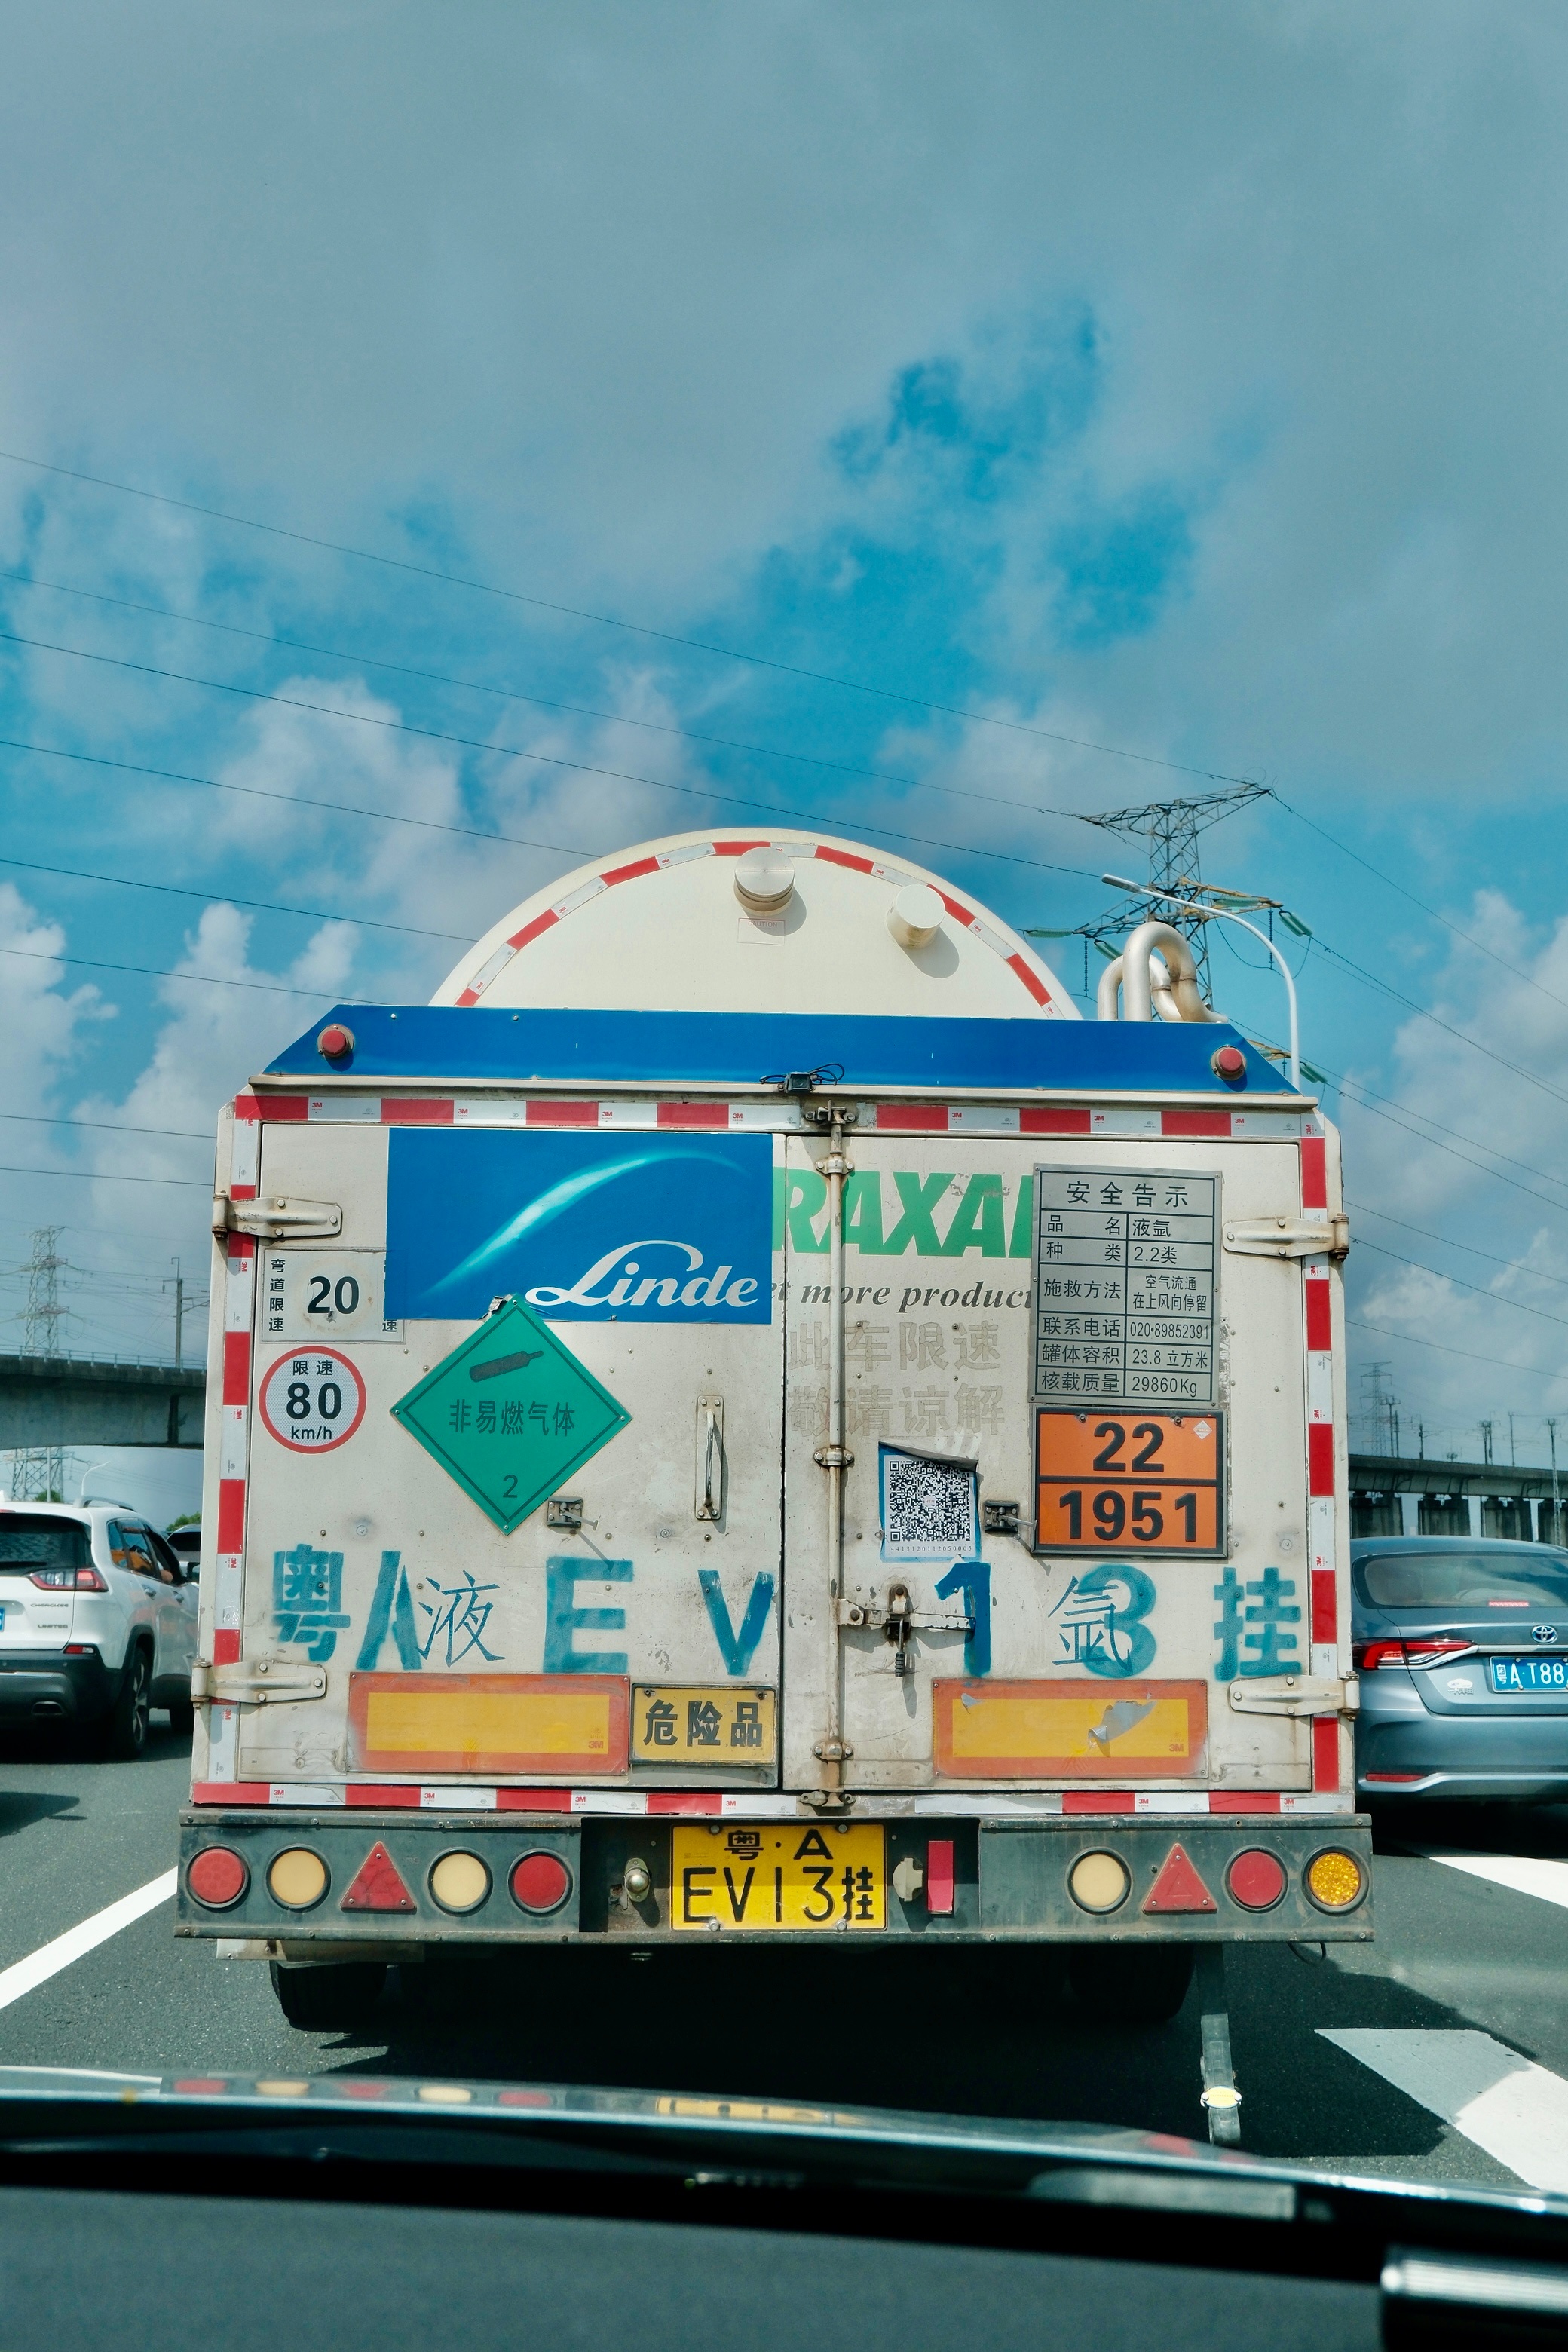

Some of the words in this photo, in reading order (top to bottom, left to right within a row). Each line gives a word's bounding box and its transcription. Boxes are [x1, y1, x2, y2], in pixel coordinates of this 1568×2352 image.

[1067, 1181, 1188, 1208] 安全告示
[1132, 1218, 1171, 1238] 液氩
[241, 1260, 247, 1272] 3M
[1133, 1246, 1178, 1265] 2.2类
[525, 1239, 758, 1308] Linde
[1145, 1274, 1197, 1291] 空气流通
[268, 1258, 286, 1332] 弯道限速
[307, 1276, 360, 1315] 20
[801, 1285, 891, 1305] more
[1043, 1279, 1122, 1300] 施救方法
[1132, 1291, 1207, 1312] 在上风向停留
[1042, 1316, 1121, 1338] 联系电话
[788, 1320, 1000, 1372] 此车限速
[1042, 1343, 1120, 1364] 罐体容积
[1132, 1349, 1162, 1365] 23.8
[1166, 1349, 1208, 1369] 立方米
[292, 1360, 334, 1376] 限速
[1041, 1370, 1120, 1393] 核载质量
[1132, 1376, 1197, 1398] 29860Kg
[286, 1382, 342, 1420] 80
[788, 1383, 1005, 1437] 敬请谅解
[236, 1408, 243, 1419] 3M
[449, 1399, 575, 1437] 非易燃气体
[1314, 1409, 1319, 1420] 3M
[291, 1426, 332, 1440] km/h
[1093, 1422, 1165, 1472] 22
[502, 1474, 519, 1498] 2
[1059, 1490, 1197, 1542] 1951
[231, 1557, 237, 1569] 3M
[1316, 1555, 1322, 1567] 3M
[643, 1698, 763, 1747] 危险品
[588, 1741, 604, 1749] 3M
[1169, 1744, 1184, 1752] 3M
[683, 1866, 874, 1922] EV13挂
